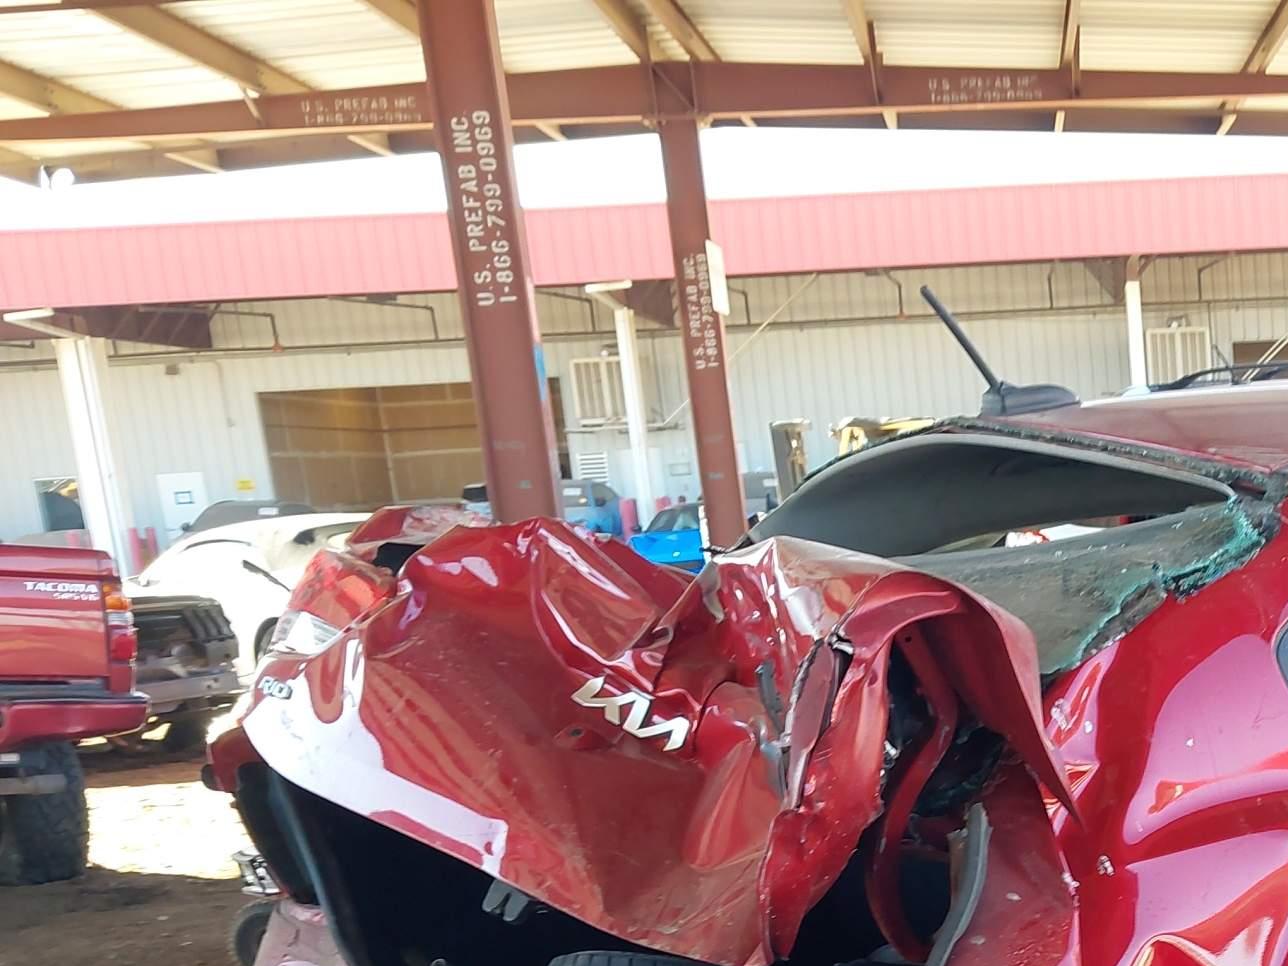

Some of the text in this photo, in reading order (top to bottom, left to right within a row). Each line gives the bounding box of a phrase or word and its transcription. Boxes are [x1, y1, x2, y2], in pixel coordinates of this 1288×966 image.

[457, 164, 487, 252] PREFAB
[472, 110, 518, 303] 1-866-799-0969
[685, 285, 703, 338] PREFAB
[23, 581, 99, 593] TACOMA
[262, 675, 293, 699] RIO
[571, 676, 690, 752] KIA
